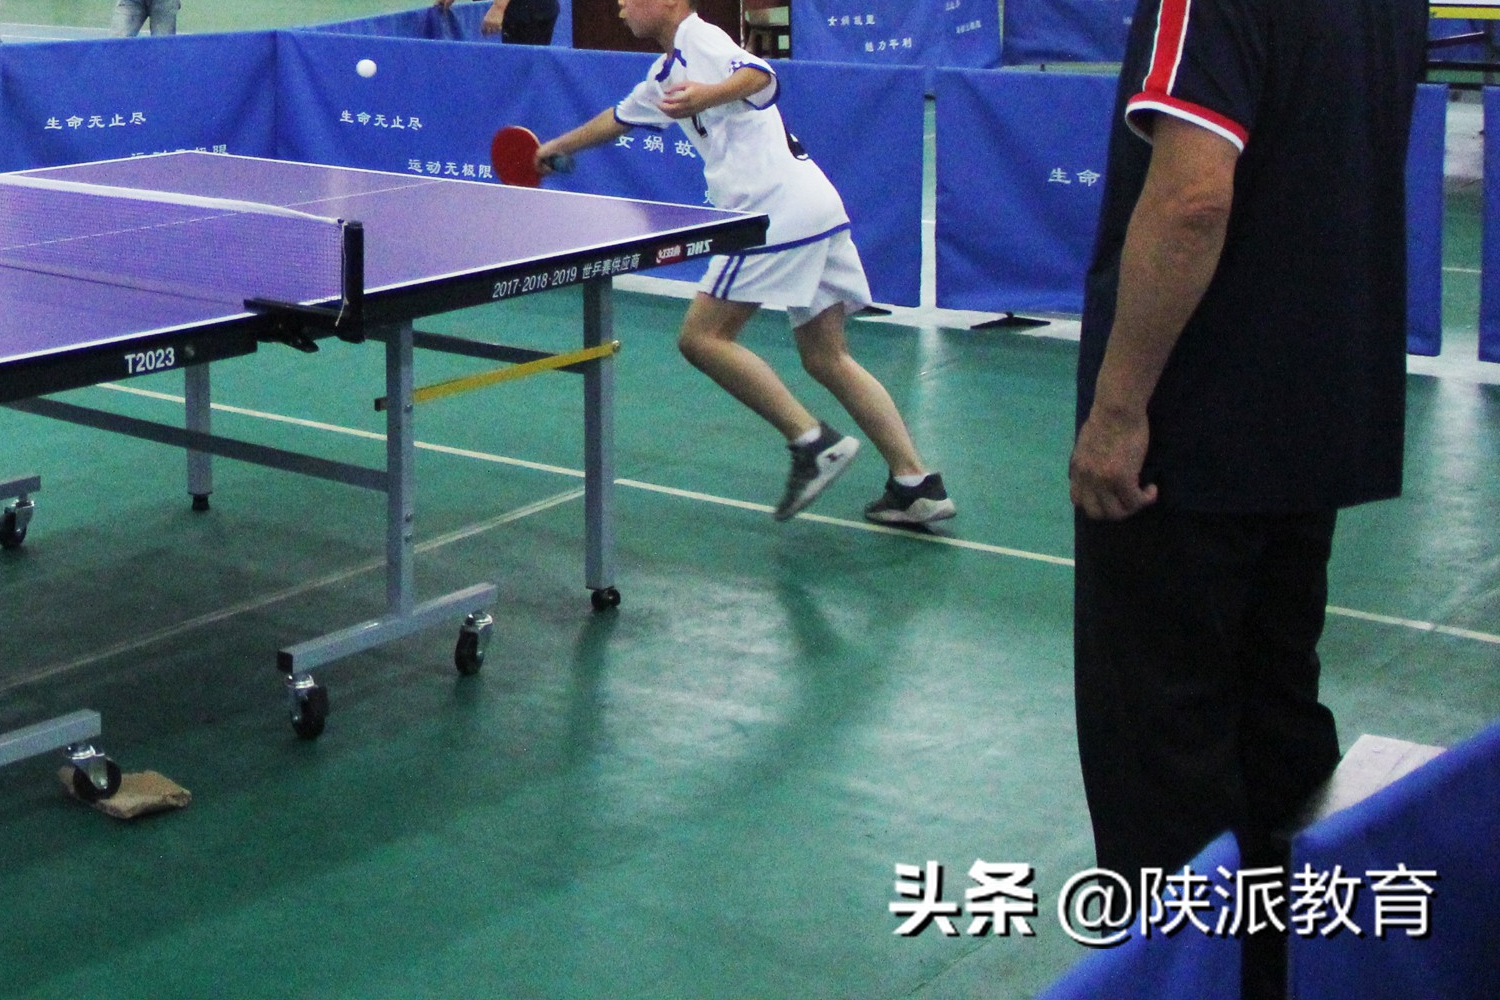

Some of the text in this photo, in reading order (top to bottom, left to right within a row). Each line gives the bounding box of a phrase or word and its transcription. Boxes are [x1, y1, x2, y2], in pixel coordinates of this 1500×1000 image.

[44, 112, 147, 130] 生命无止尽
[340, 109, 423, 131] 生命无止尽
[408, 159, 493, 179] 运动无极限
[1048, 167, 1101, 187] 生命
[686, 239, 713, 256] DHS
[582, 253, 642, 280] 世乒赛供应商
[124, 347, 175, 374] T2023
